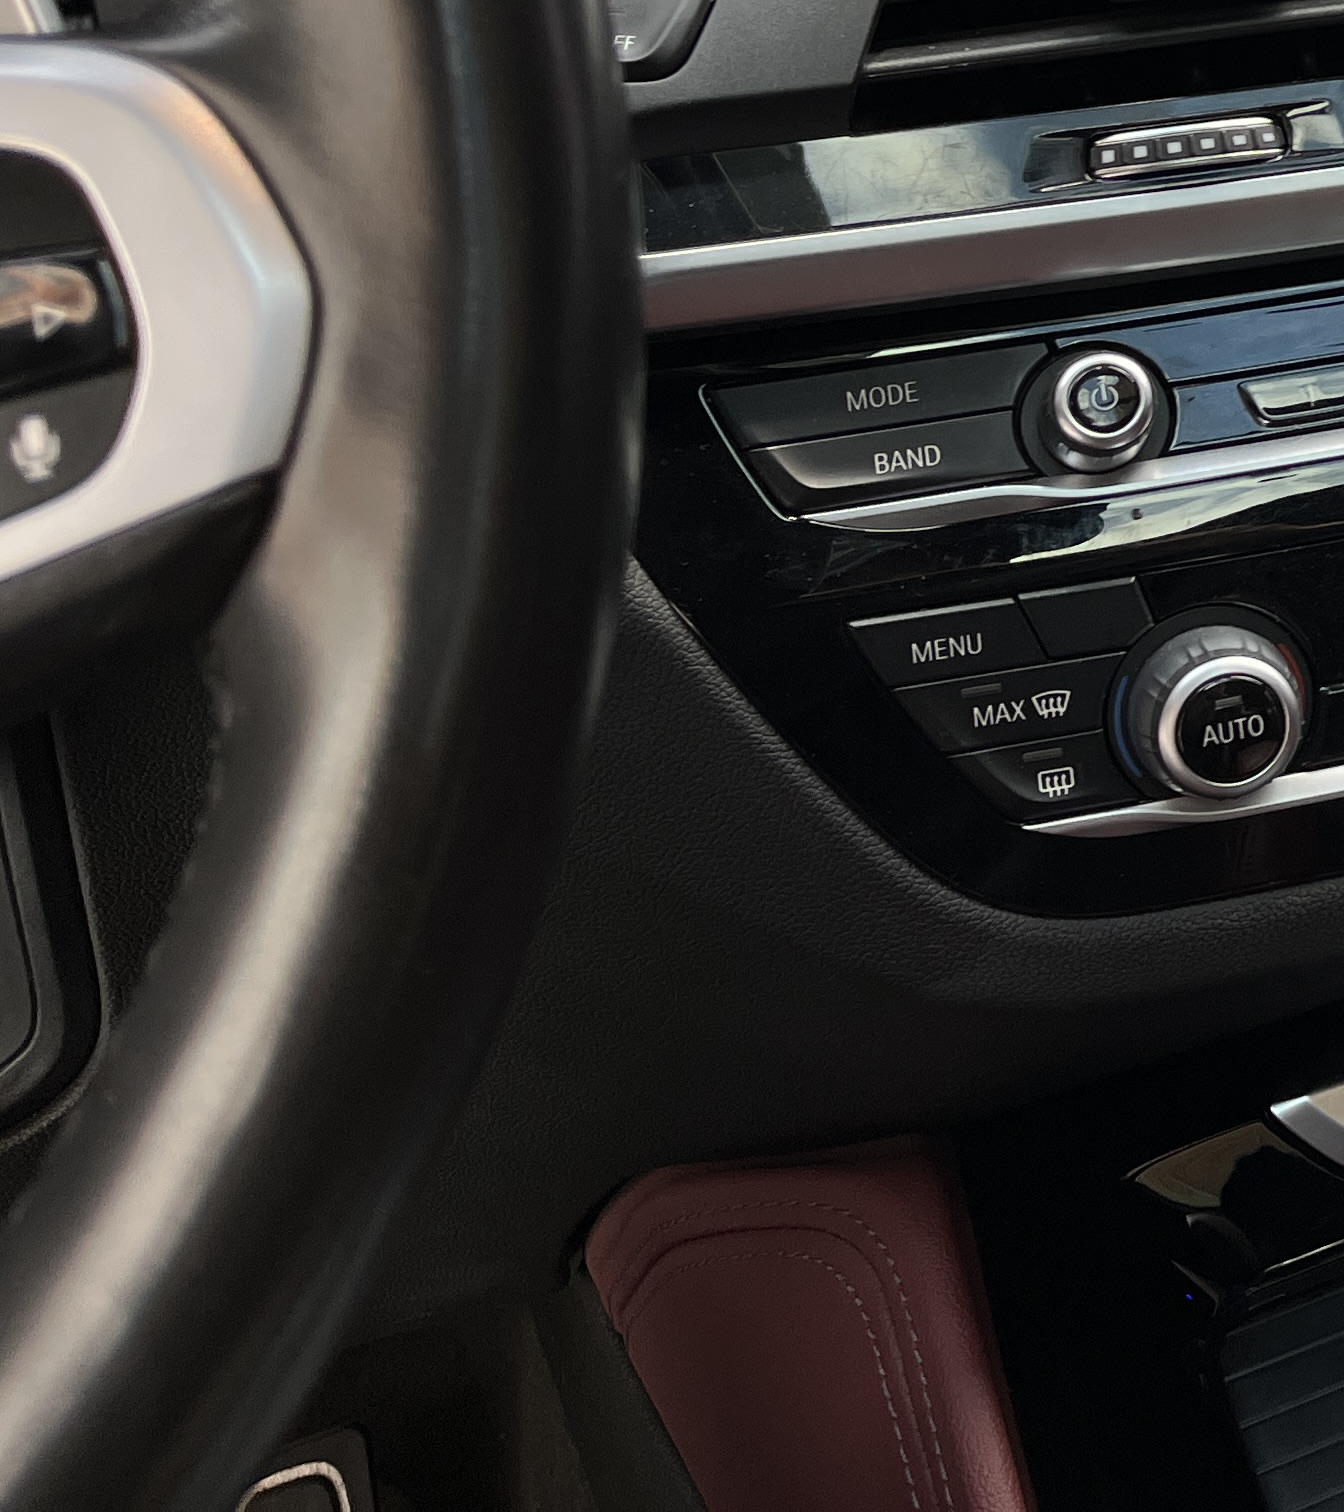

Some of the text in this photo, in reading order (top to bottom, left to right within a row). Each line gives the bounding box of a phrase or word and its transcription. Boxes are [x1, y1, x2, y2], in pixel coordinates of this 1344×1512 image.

[845, 381, 920, 412] MODE
[873, 444, 942, 476] BAND
[911, 632, 983, 665] MENU
[972, 699, 1027, 729] MAX
[1202, 713, 1265, 749] AUTO
